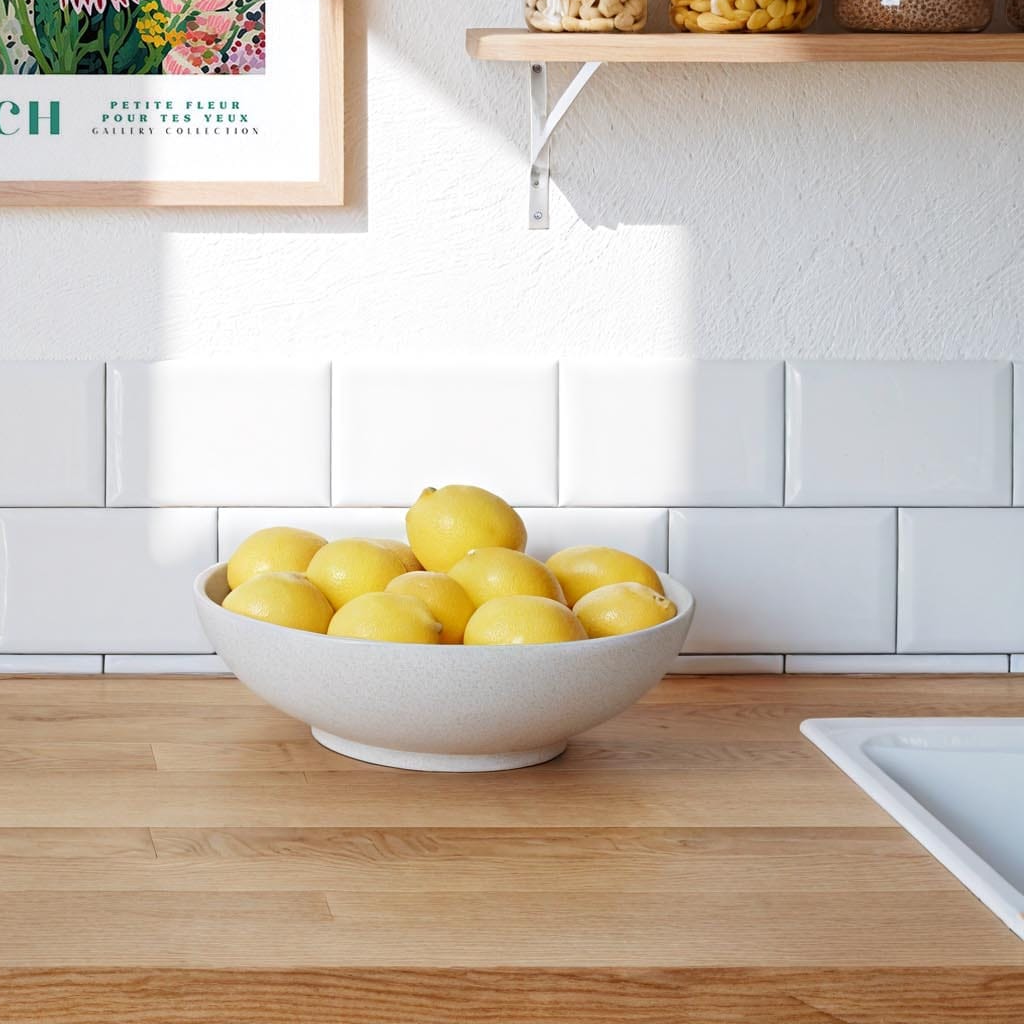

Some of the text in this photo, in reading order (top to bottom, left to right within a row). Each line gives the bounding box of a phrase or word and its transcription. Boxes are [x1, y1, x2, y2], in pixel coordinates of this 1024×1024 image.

[110, 101, 241, 110] PETITE FLEUR
[102, 114, 249, 123] POUR TES YEUX
[91, 127, 260, 135] GALLERY COLLECTION
